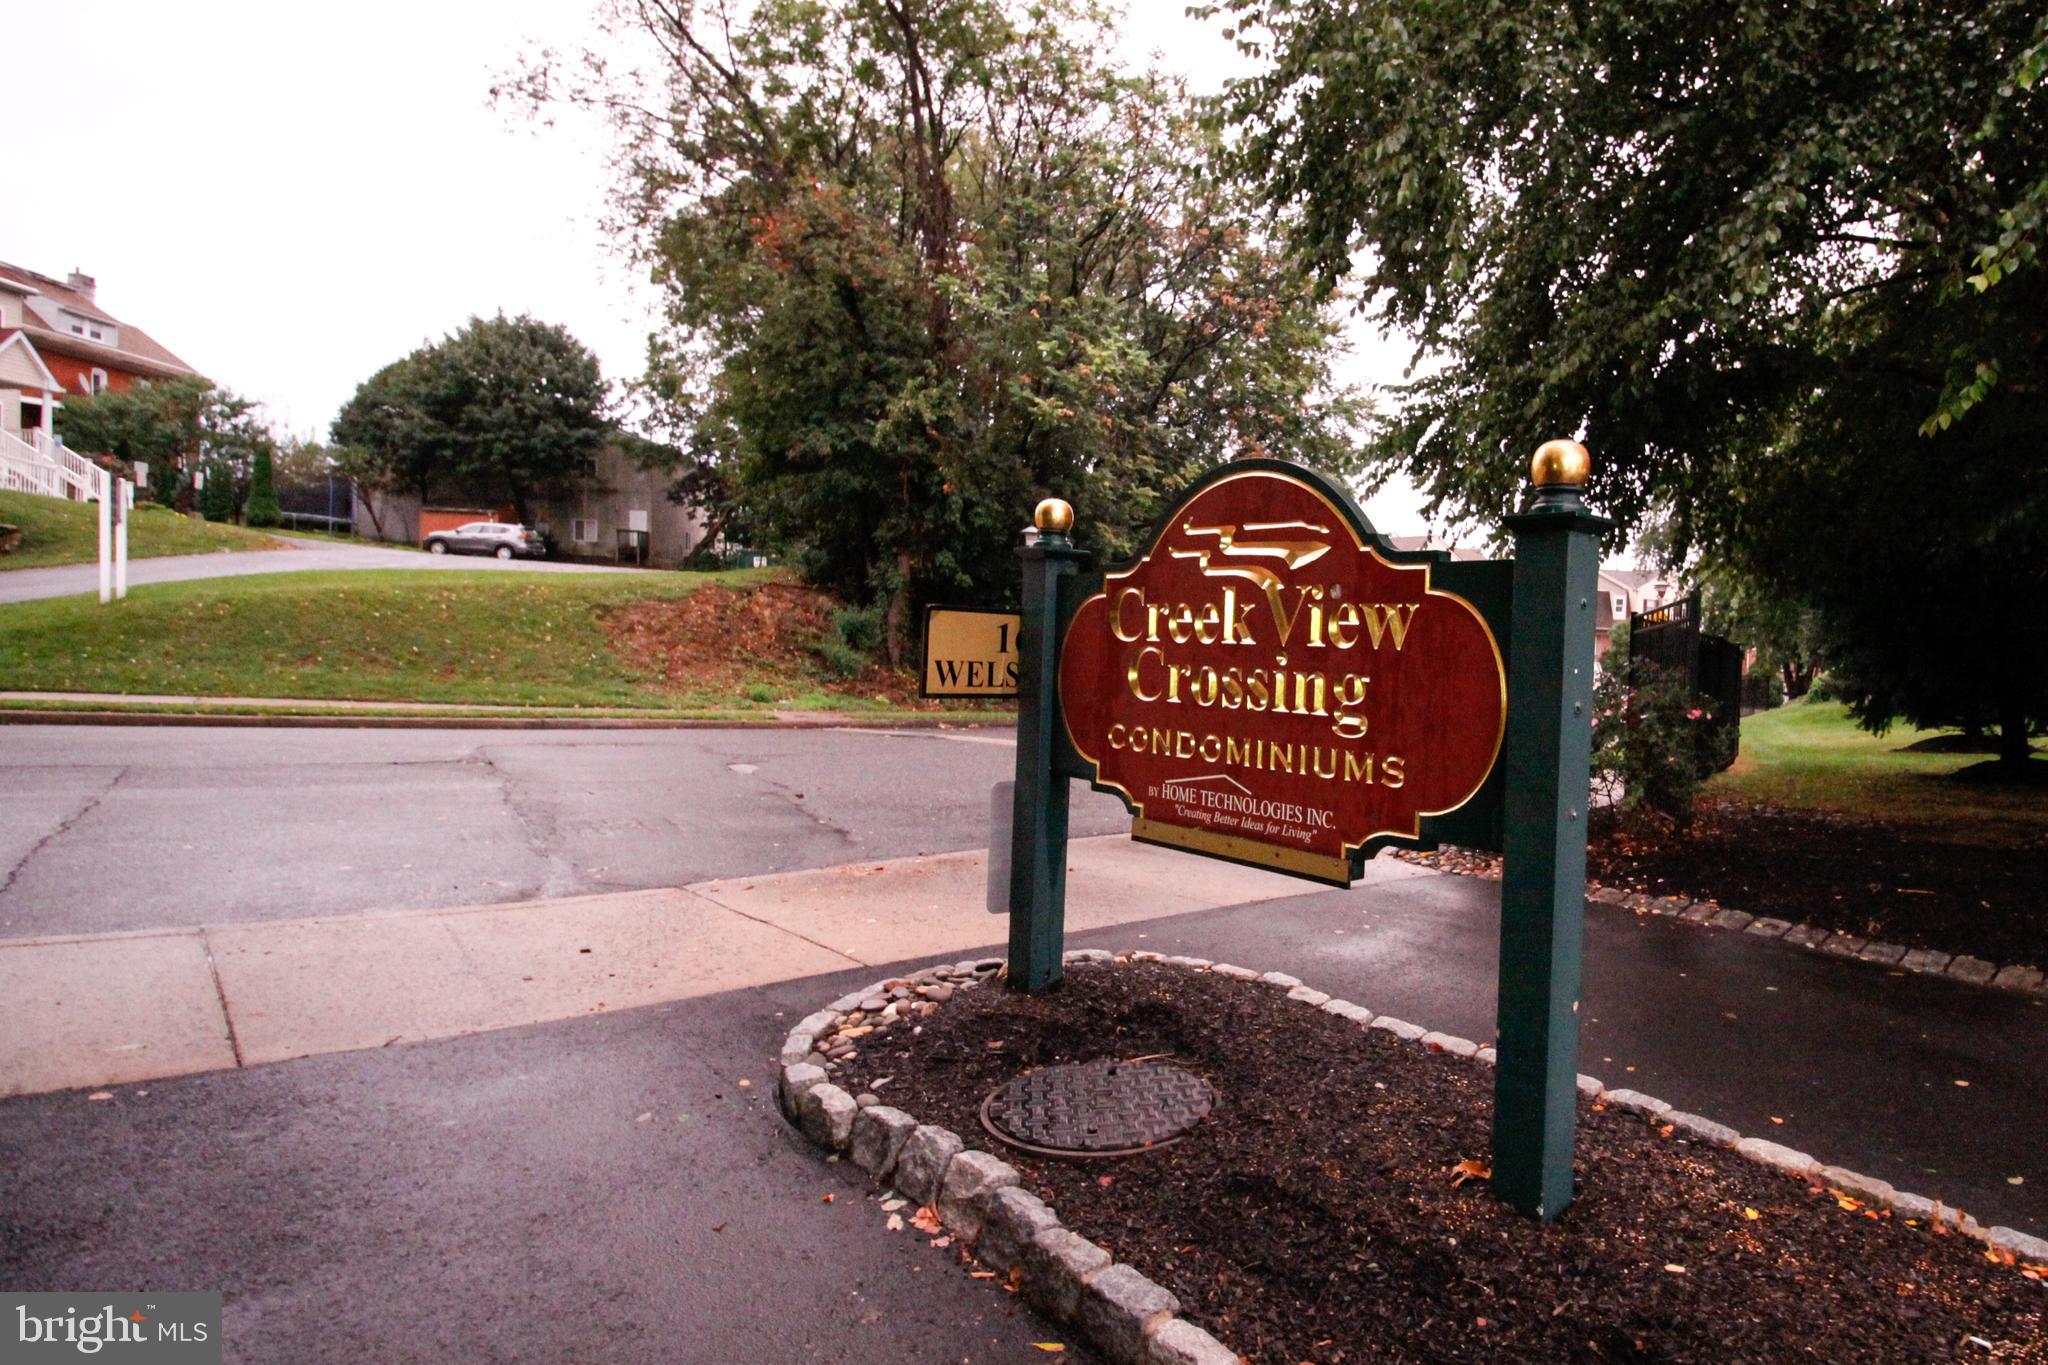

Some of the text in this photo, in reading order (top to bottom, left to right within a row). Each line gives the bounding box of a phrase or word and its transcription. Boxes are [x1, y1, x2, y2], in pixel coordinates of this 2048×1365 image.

[1110, 578, 1420, 651] Creek View
[1127, 646, 1370, 739] Crossing
[1108, 722, 1406, 789] CONDOMINIUMS
[1148, 783, 1336, 830] BY HOME TECHNOLOGIES INC.
[1213, 811, 1240, 827] Better
[1240, 817, 1264, 831] Ideas
[1264, 821, 1281, 835] for
